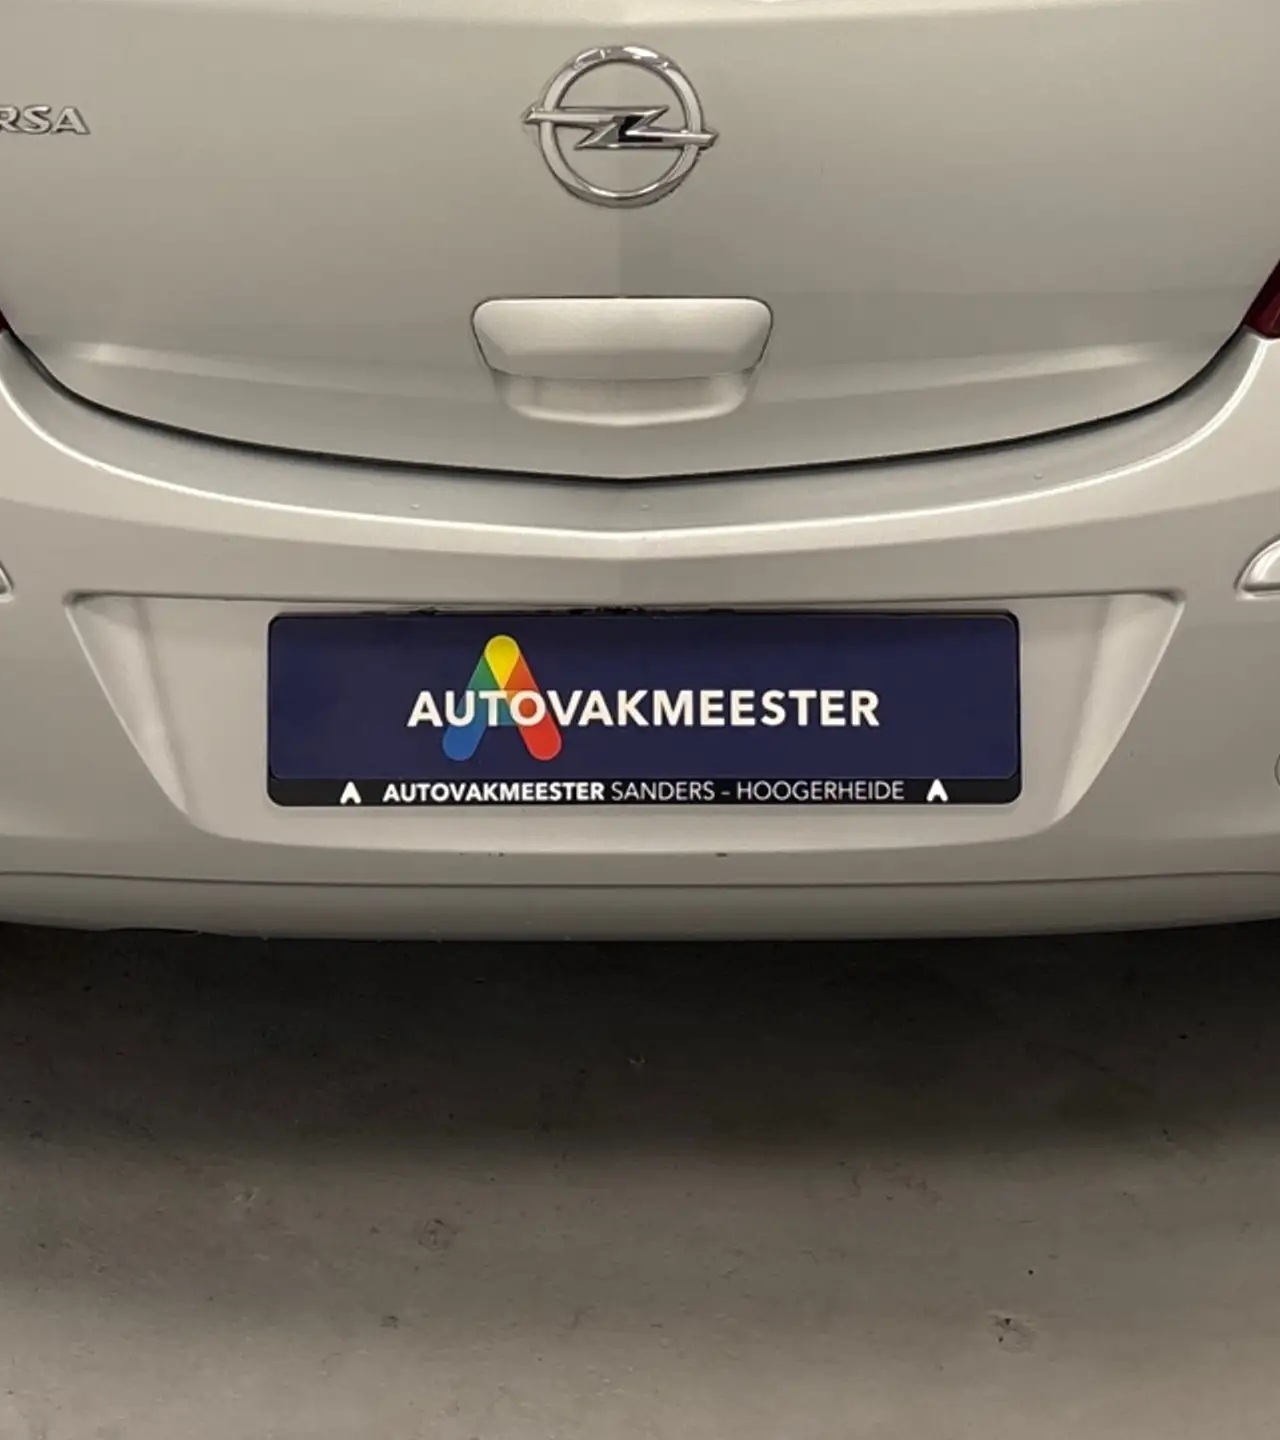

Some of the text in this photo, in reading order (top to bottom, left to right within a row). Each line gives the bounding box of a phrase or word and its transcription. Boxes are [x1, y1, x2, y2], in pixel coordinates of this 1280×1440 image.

[407, 689, 880, 728] AUTOVAKMEESTER
[382, 781, 605, 803] AUTOVAKMEESTER
[611, 780, 715, 802] SANDERS
[737, 779, 905, 801] HOOGERHEIDE
